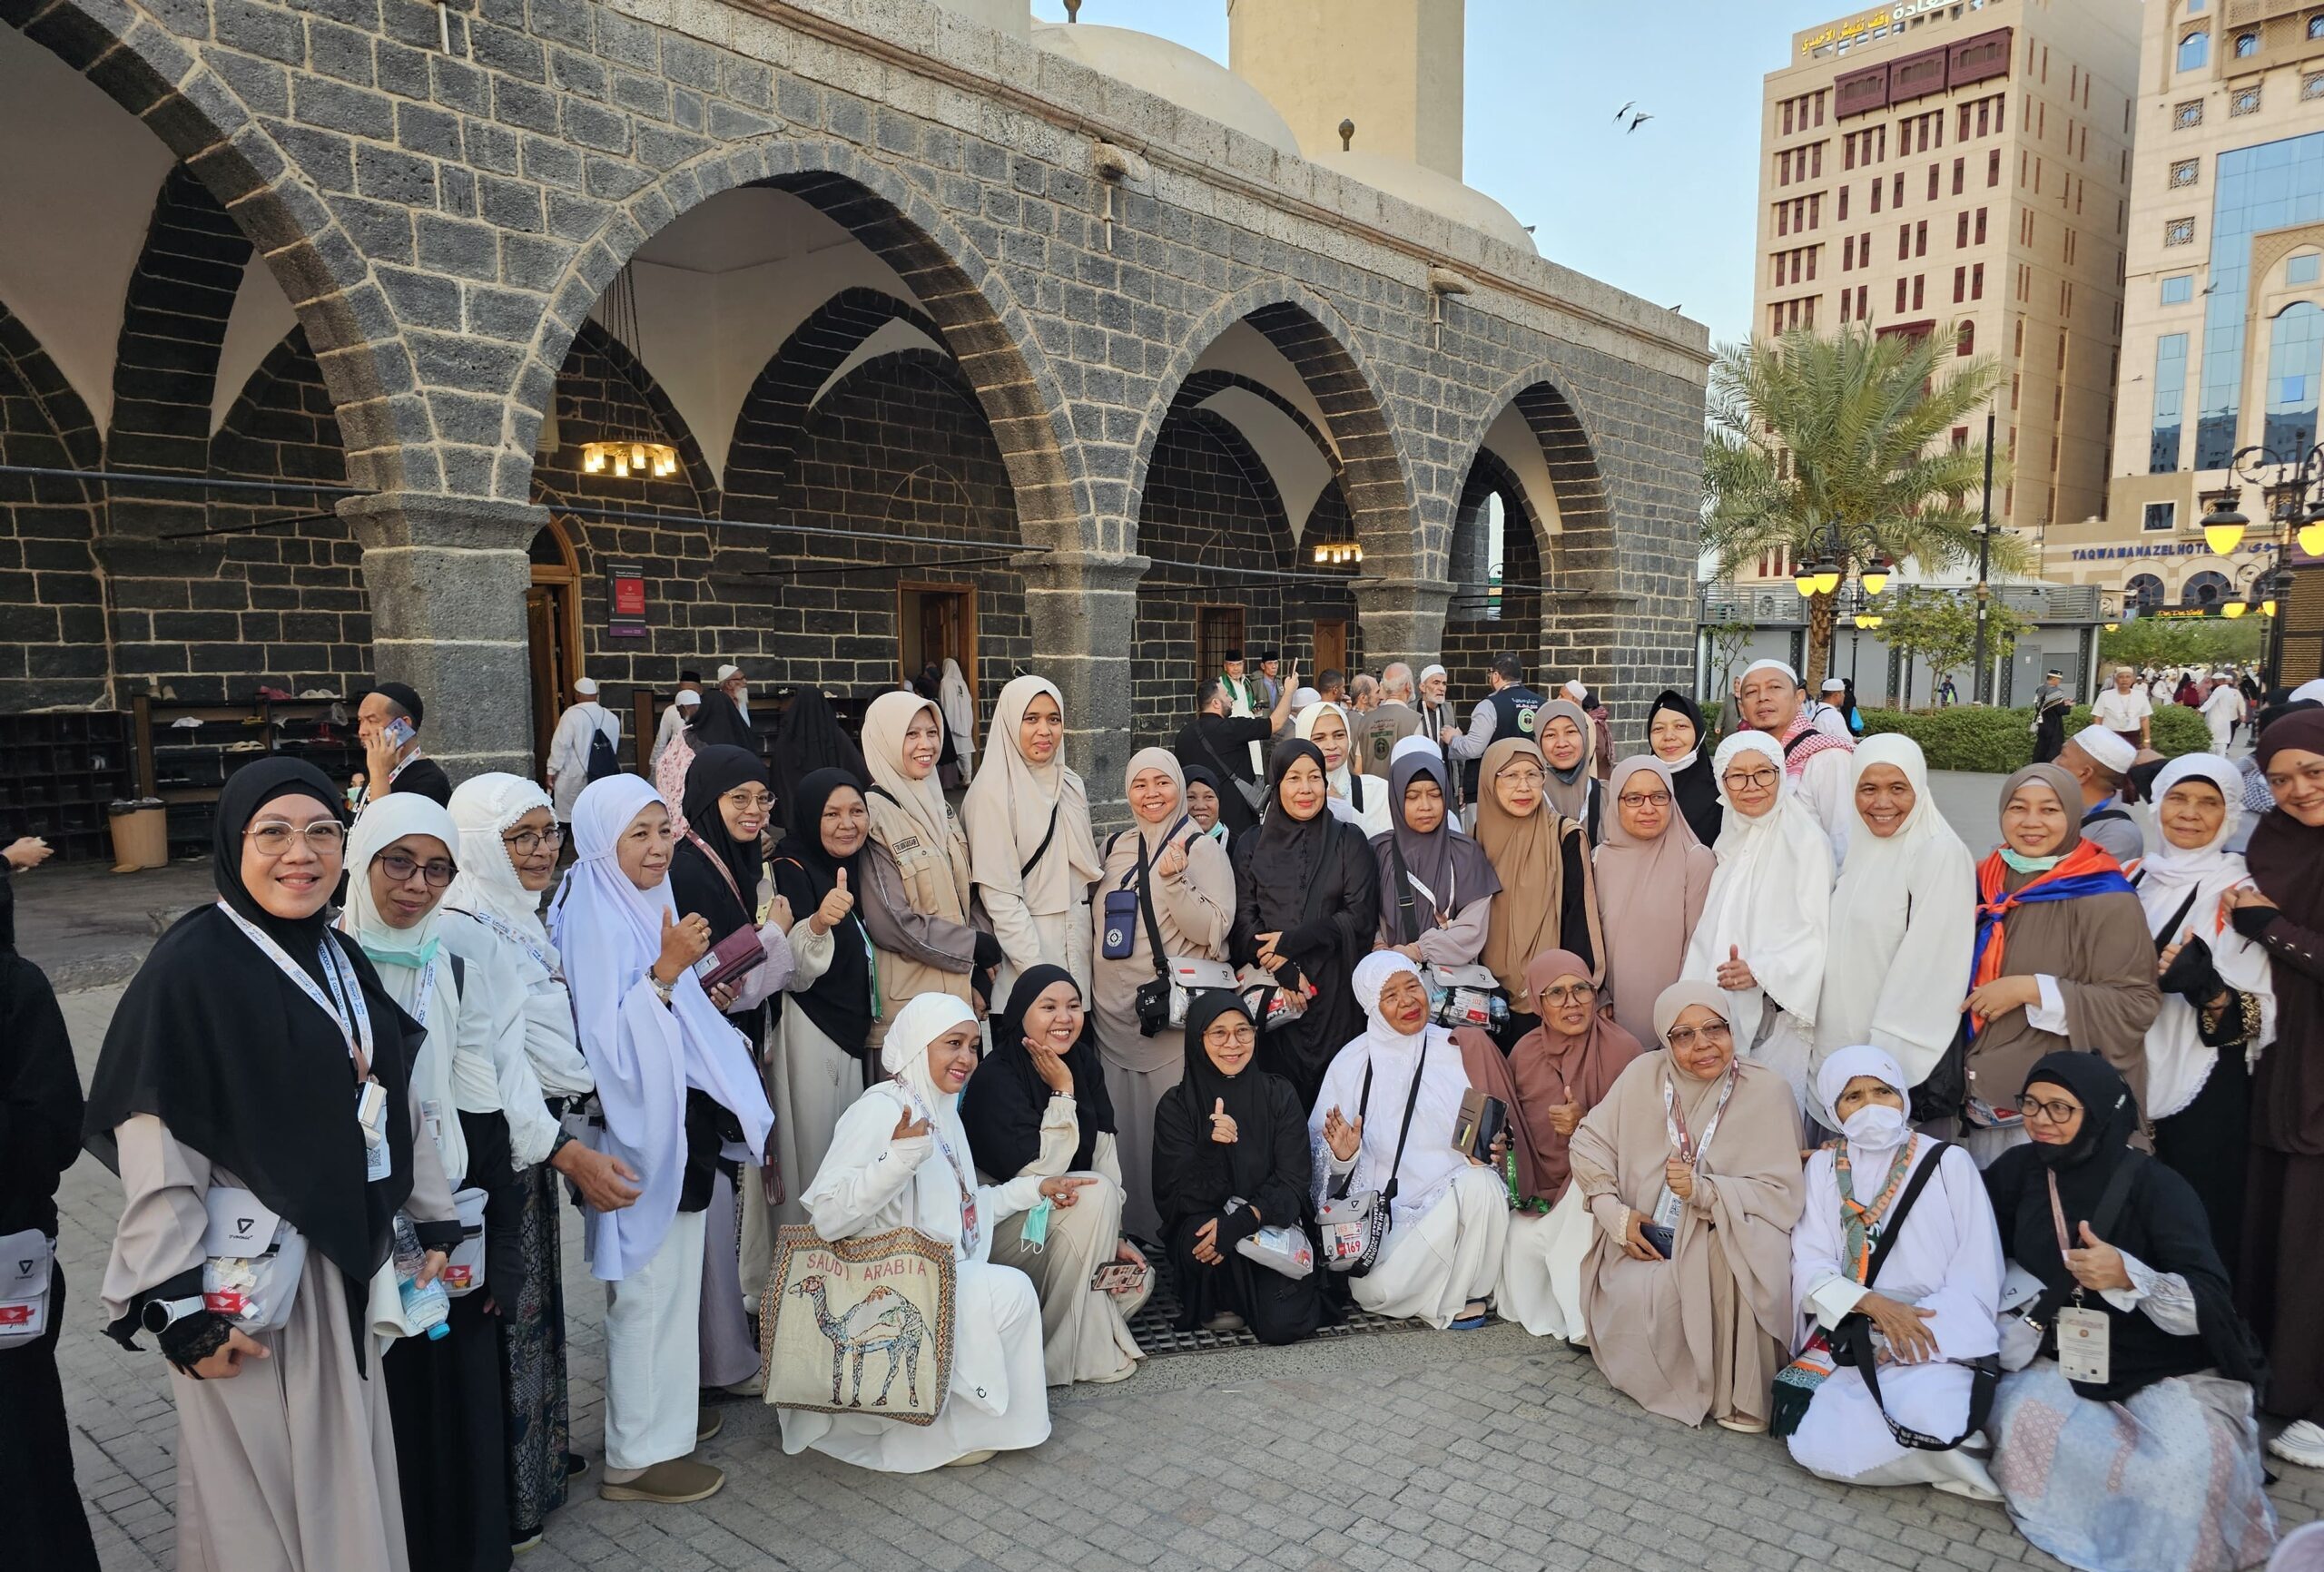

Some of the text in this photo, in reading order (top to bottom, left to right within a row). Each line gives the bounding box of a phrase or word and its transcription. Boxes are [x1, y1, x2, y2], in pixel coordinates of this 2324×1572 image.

[2072, 543, 2212, 561] TAQWA MANAZEL HOTE
[1346, 1241, 1361, 1253] 169
[806, 1253, 928, 1282] SAUDI ARABIA
